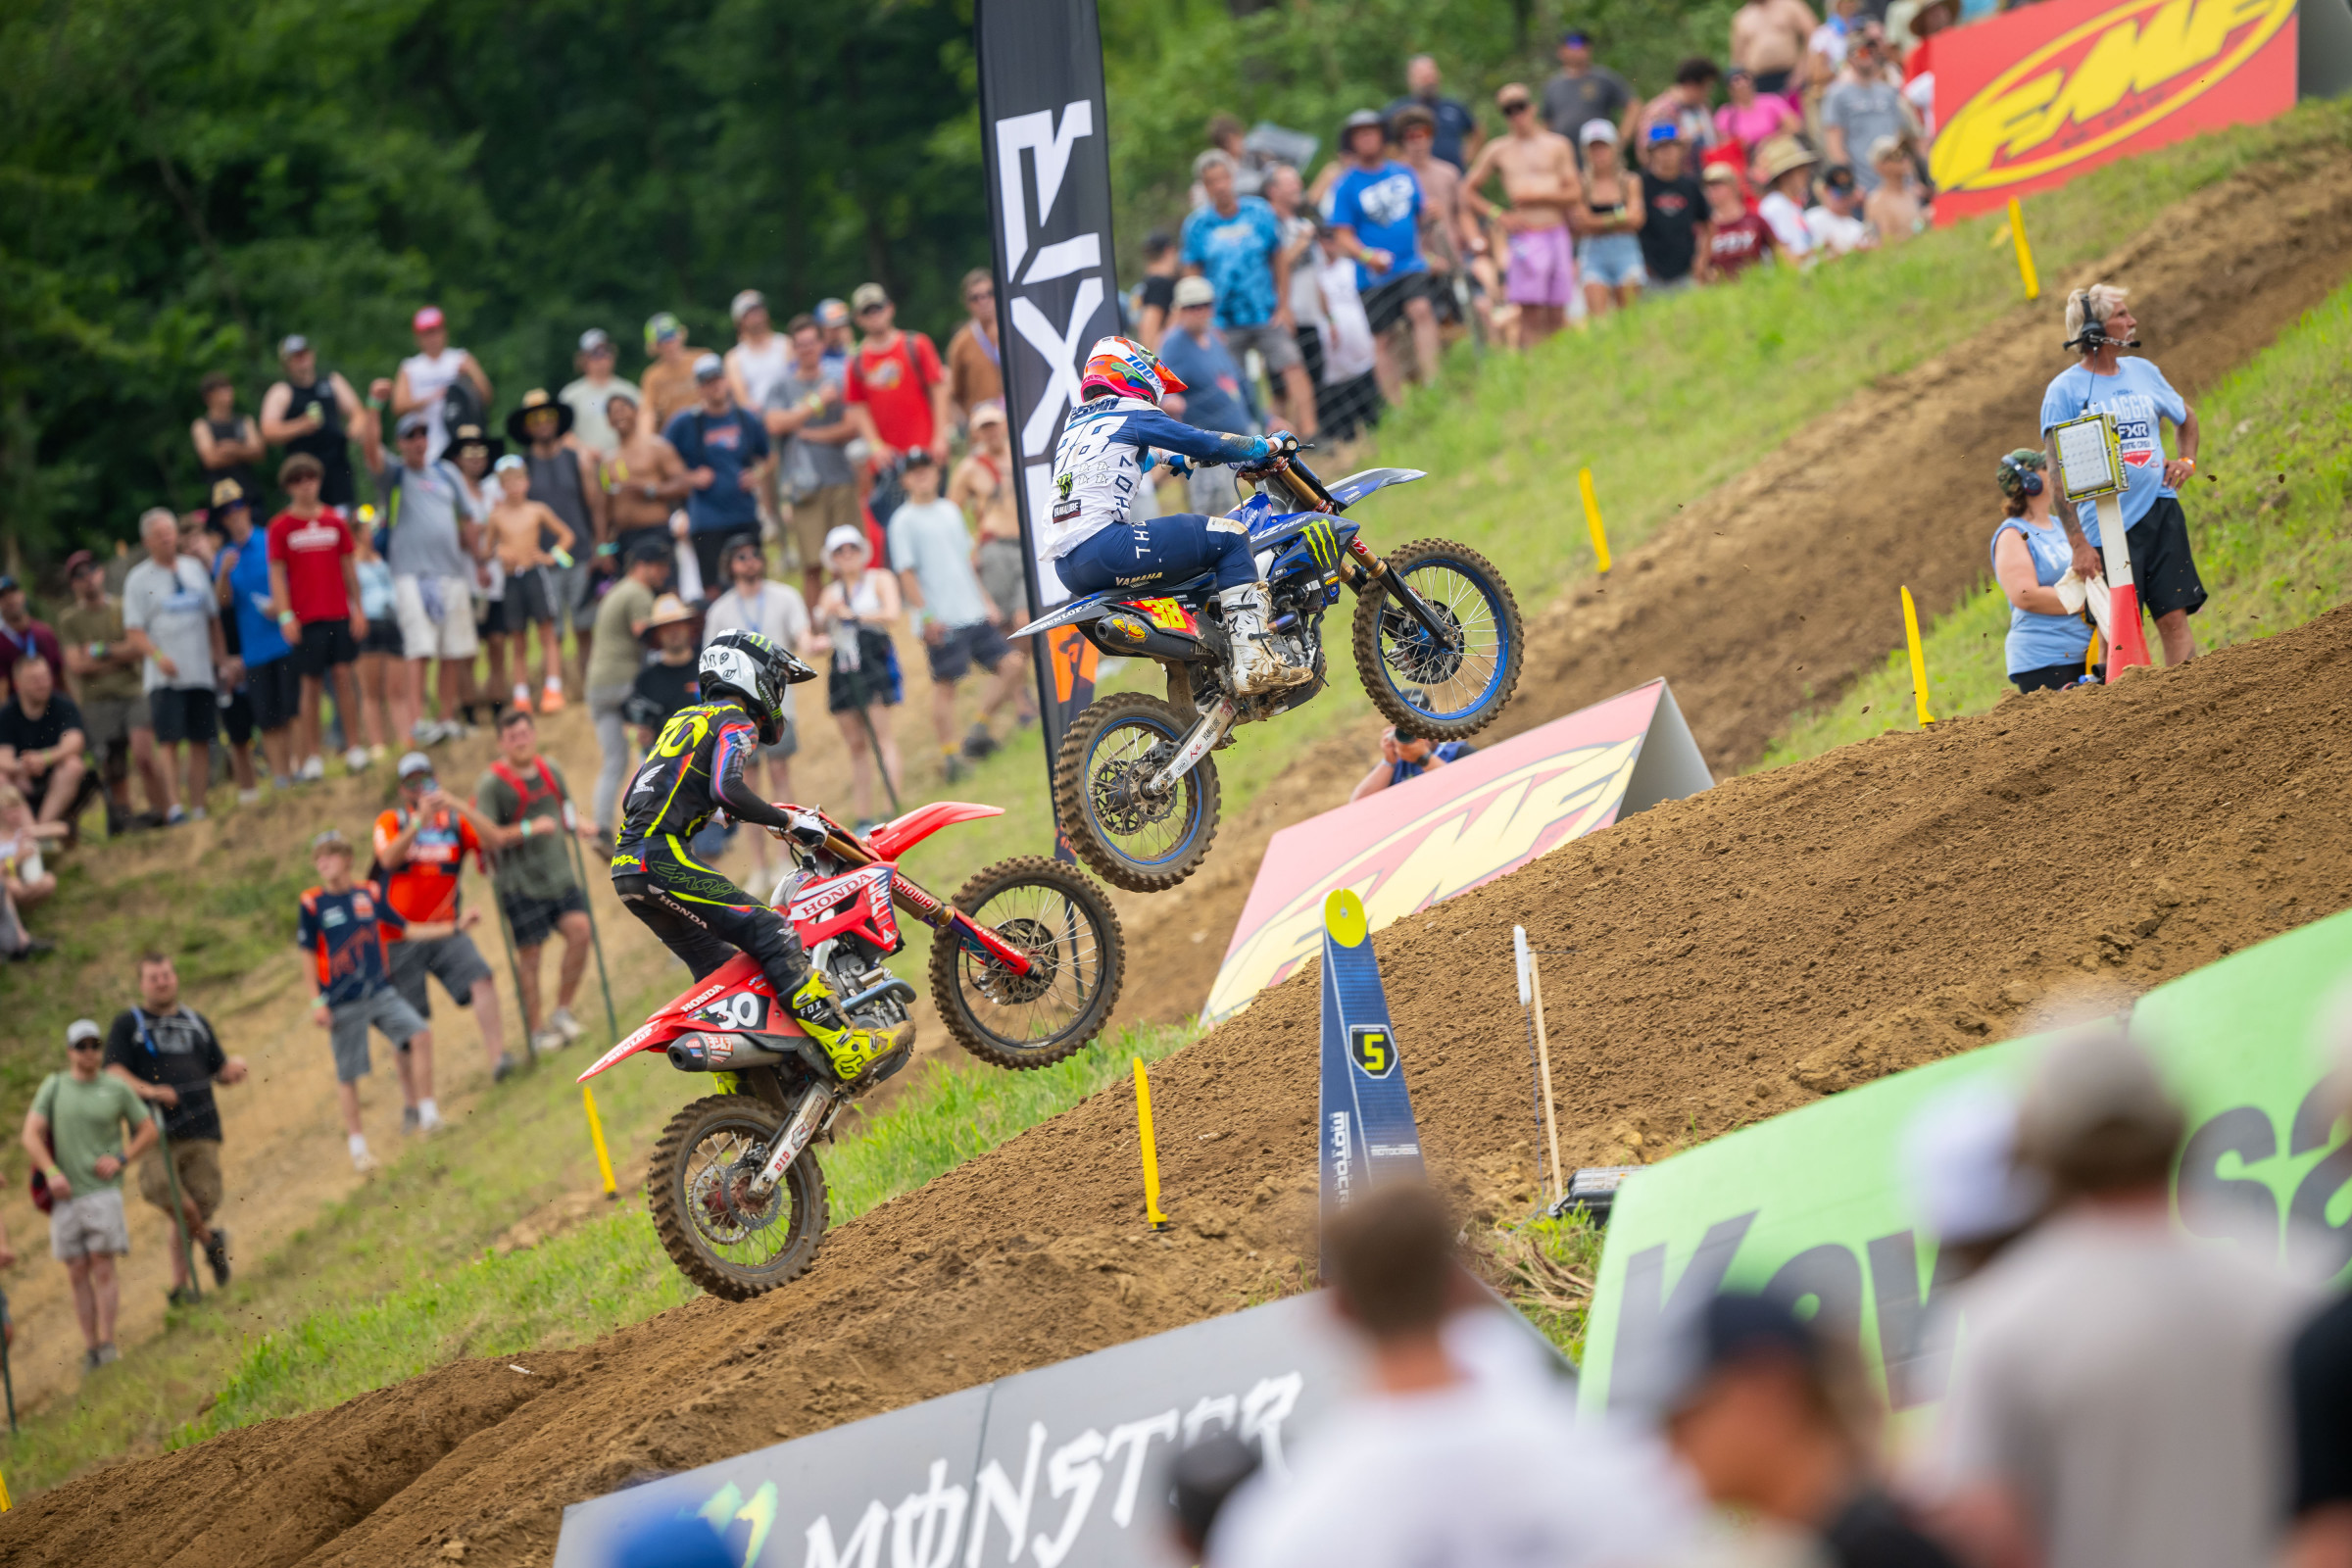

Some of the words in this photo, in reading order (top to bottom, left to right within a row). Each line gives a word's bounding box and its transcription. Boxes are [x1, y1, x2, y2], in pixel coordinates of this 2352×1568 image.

[1933, 0, 2278, 193] FMF
[1124, 354, 1161, 394] 100%
[2118, 422, 2148, 438] FXR
[1116, 572, 1163, 586] YAMAHA
[1040, 606, 1083, 630] DUNLOP
[1140, 597, 1187, 629] 38
[758, 680, 776, 710] MONSTER
[645, 714, 710, 764] 30
[1201, 717, 1221, 741] YAMALUBE
[801, 873, 873, 916] HONDA
[892, 877, 934, 909] SHOWA
[659, 894, 708, 929] HONDA
[972, 924, 1023, 956] DUNLOP
[680, 984, 725, 1013] HONDA
[708, 992, 760, 1030] 30
[800, 1000, 822, 1017] FOX
[608, 1027, 653, 1063] DUNLOP
[1363, 1034, 1384, 1070] 5
